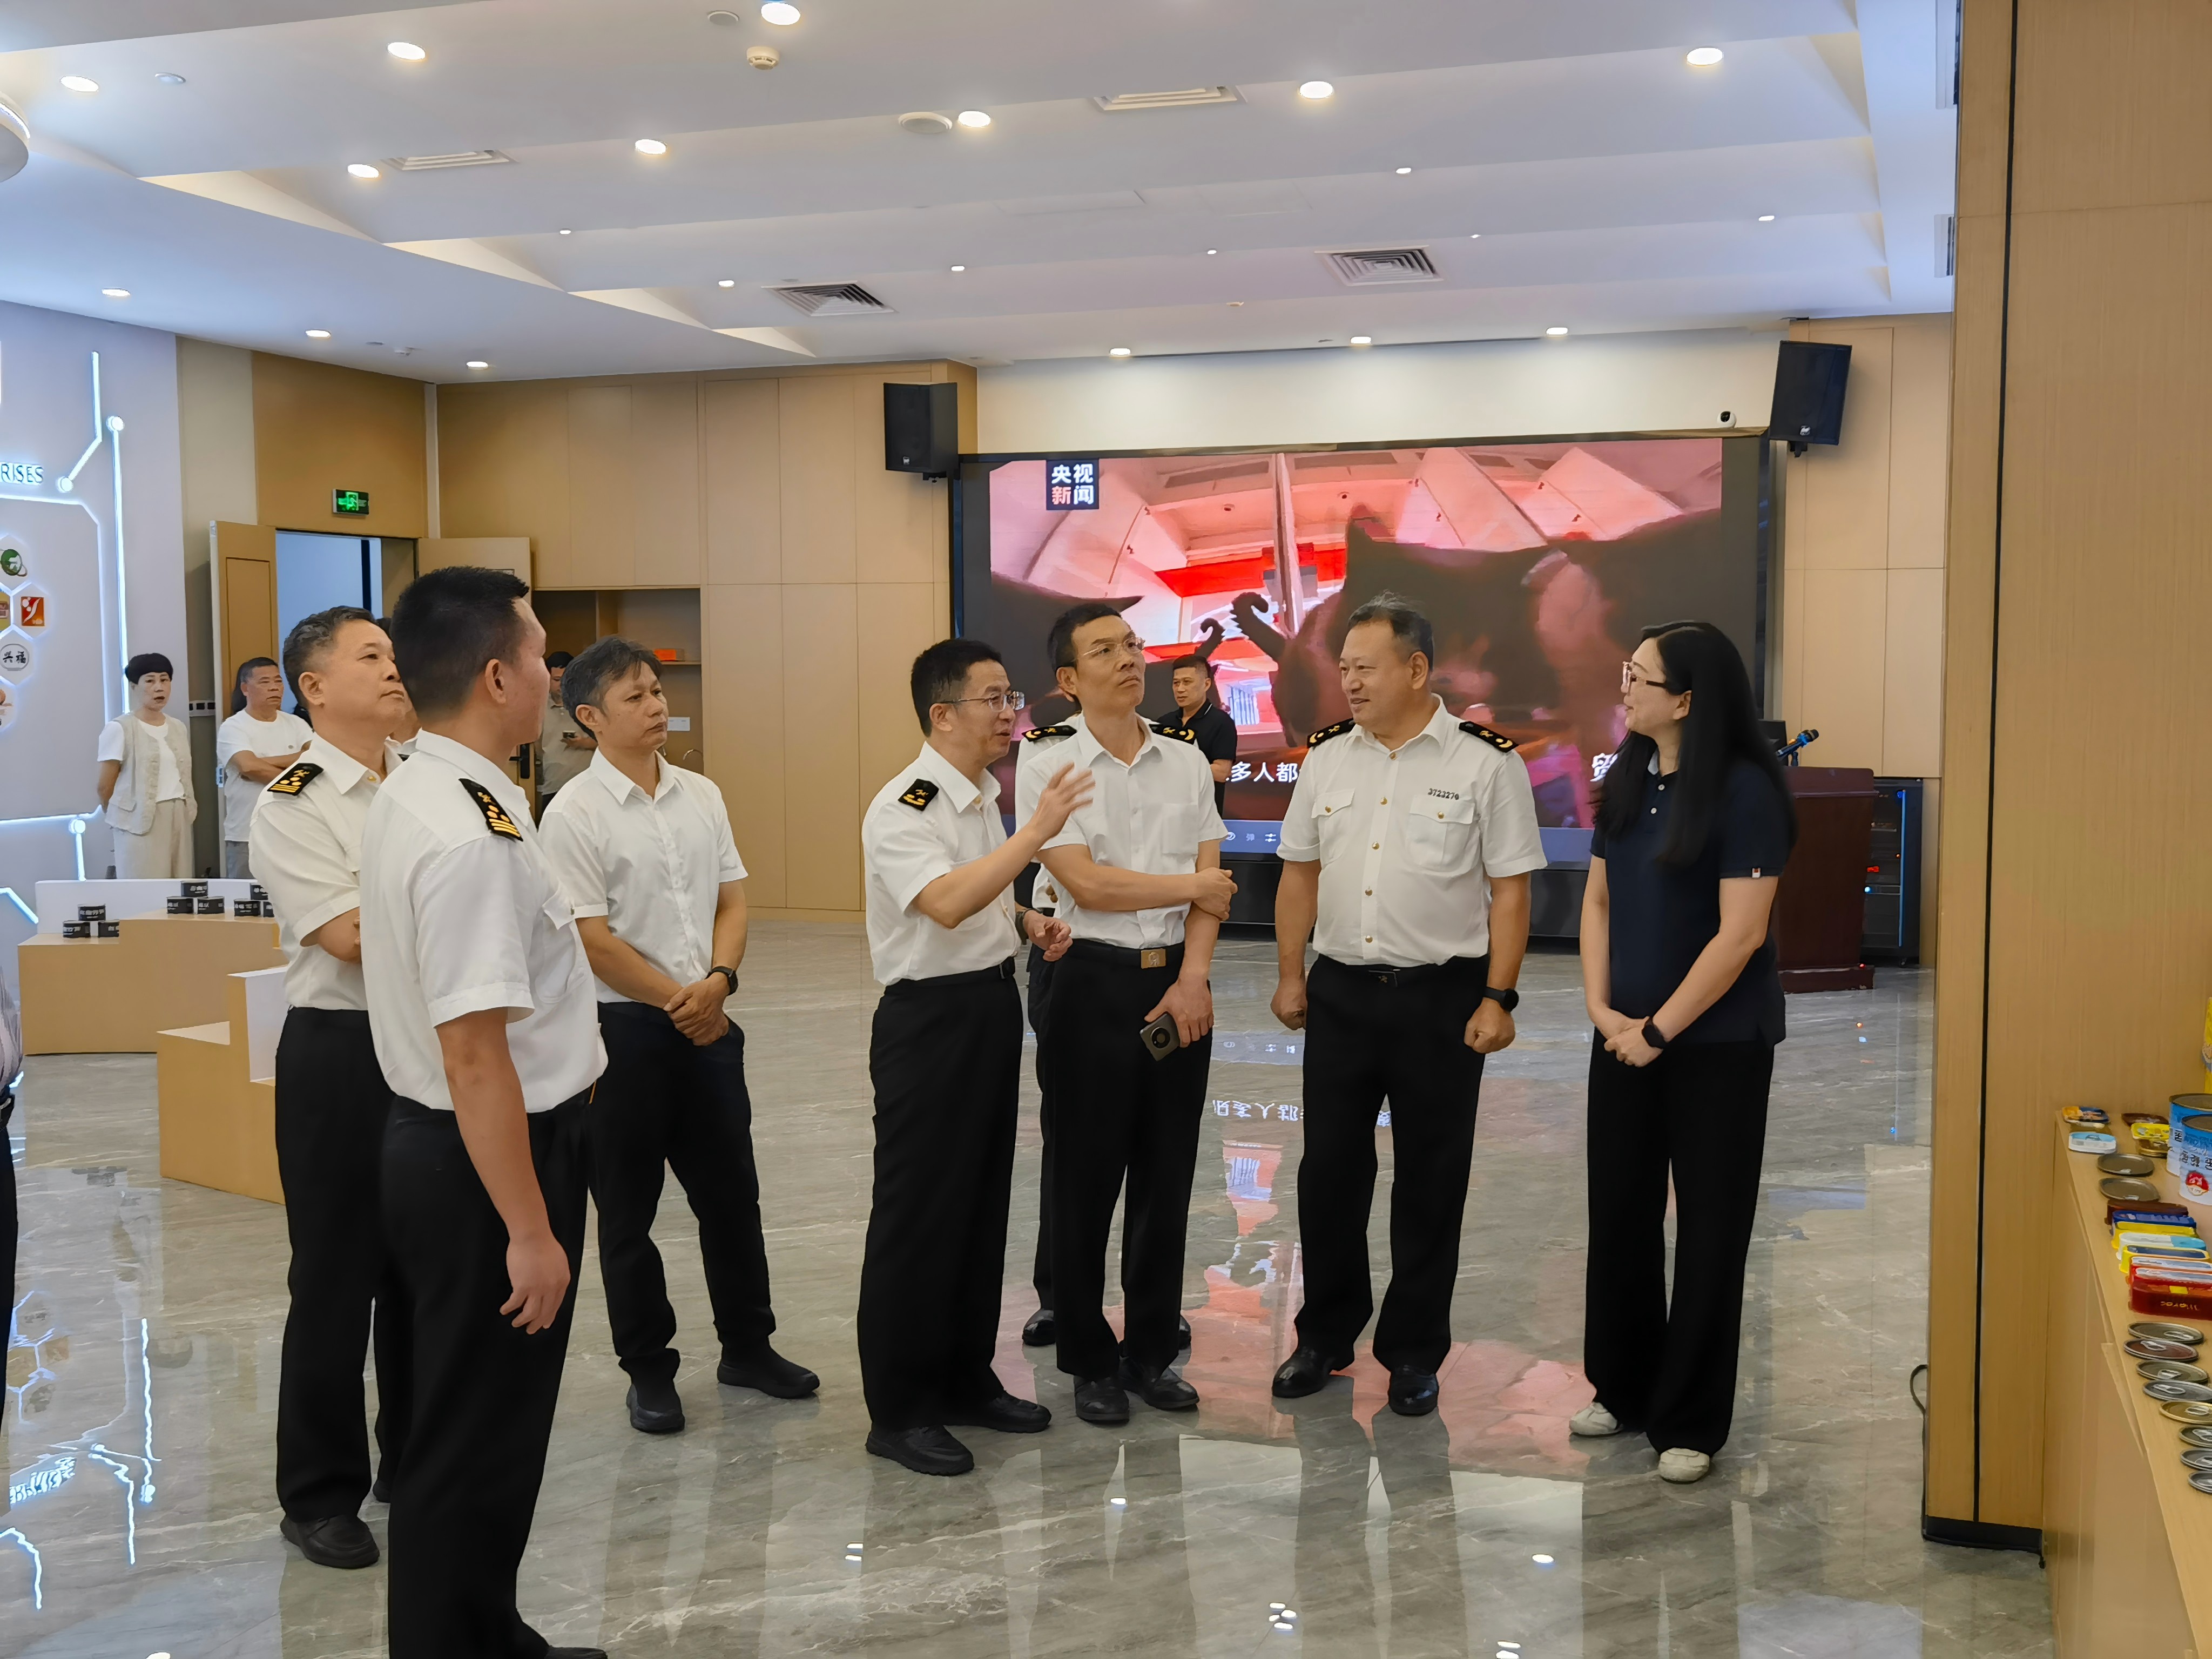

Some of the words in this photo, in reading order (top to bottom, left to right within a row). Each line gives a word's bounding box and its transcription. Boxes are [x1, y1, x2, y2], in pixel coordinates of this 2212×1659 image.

[1051, 463, 1094, 484] 央视
[1051, 485, 1094, 505] 新闻
[1225, 761, 1299, 783] 多人都
